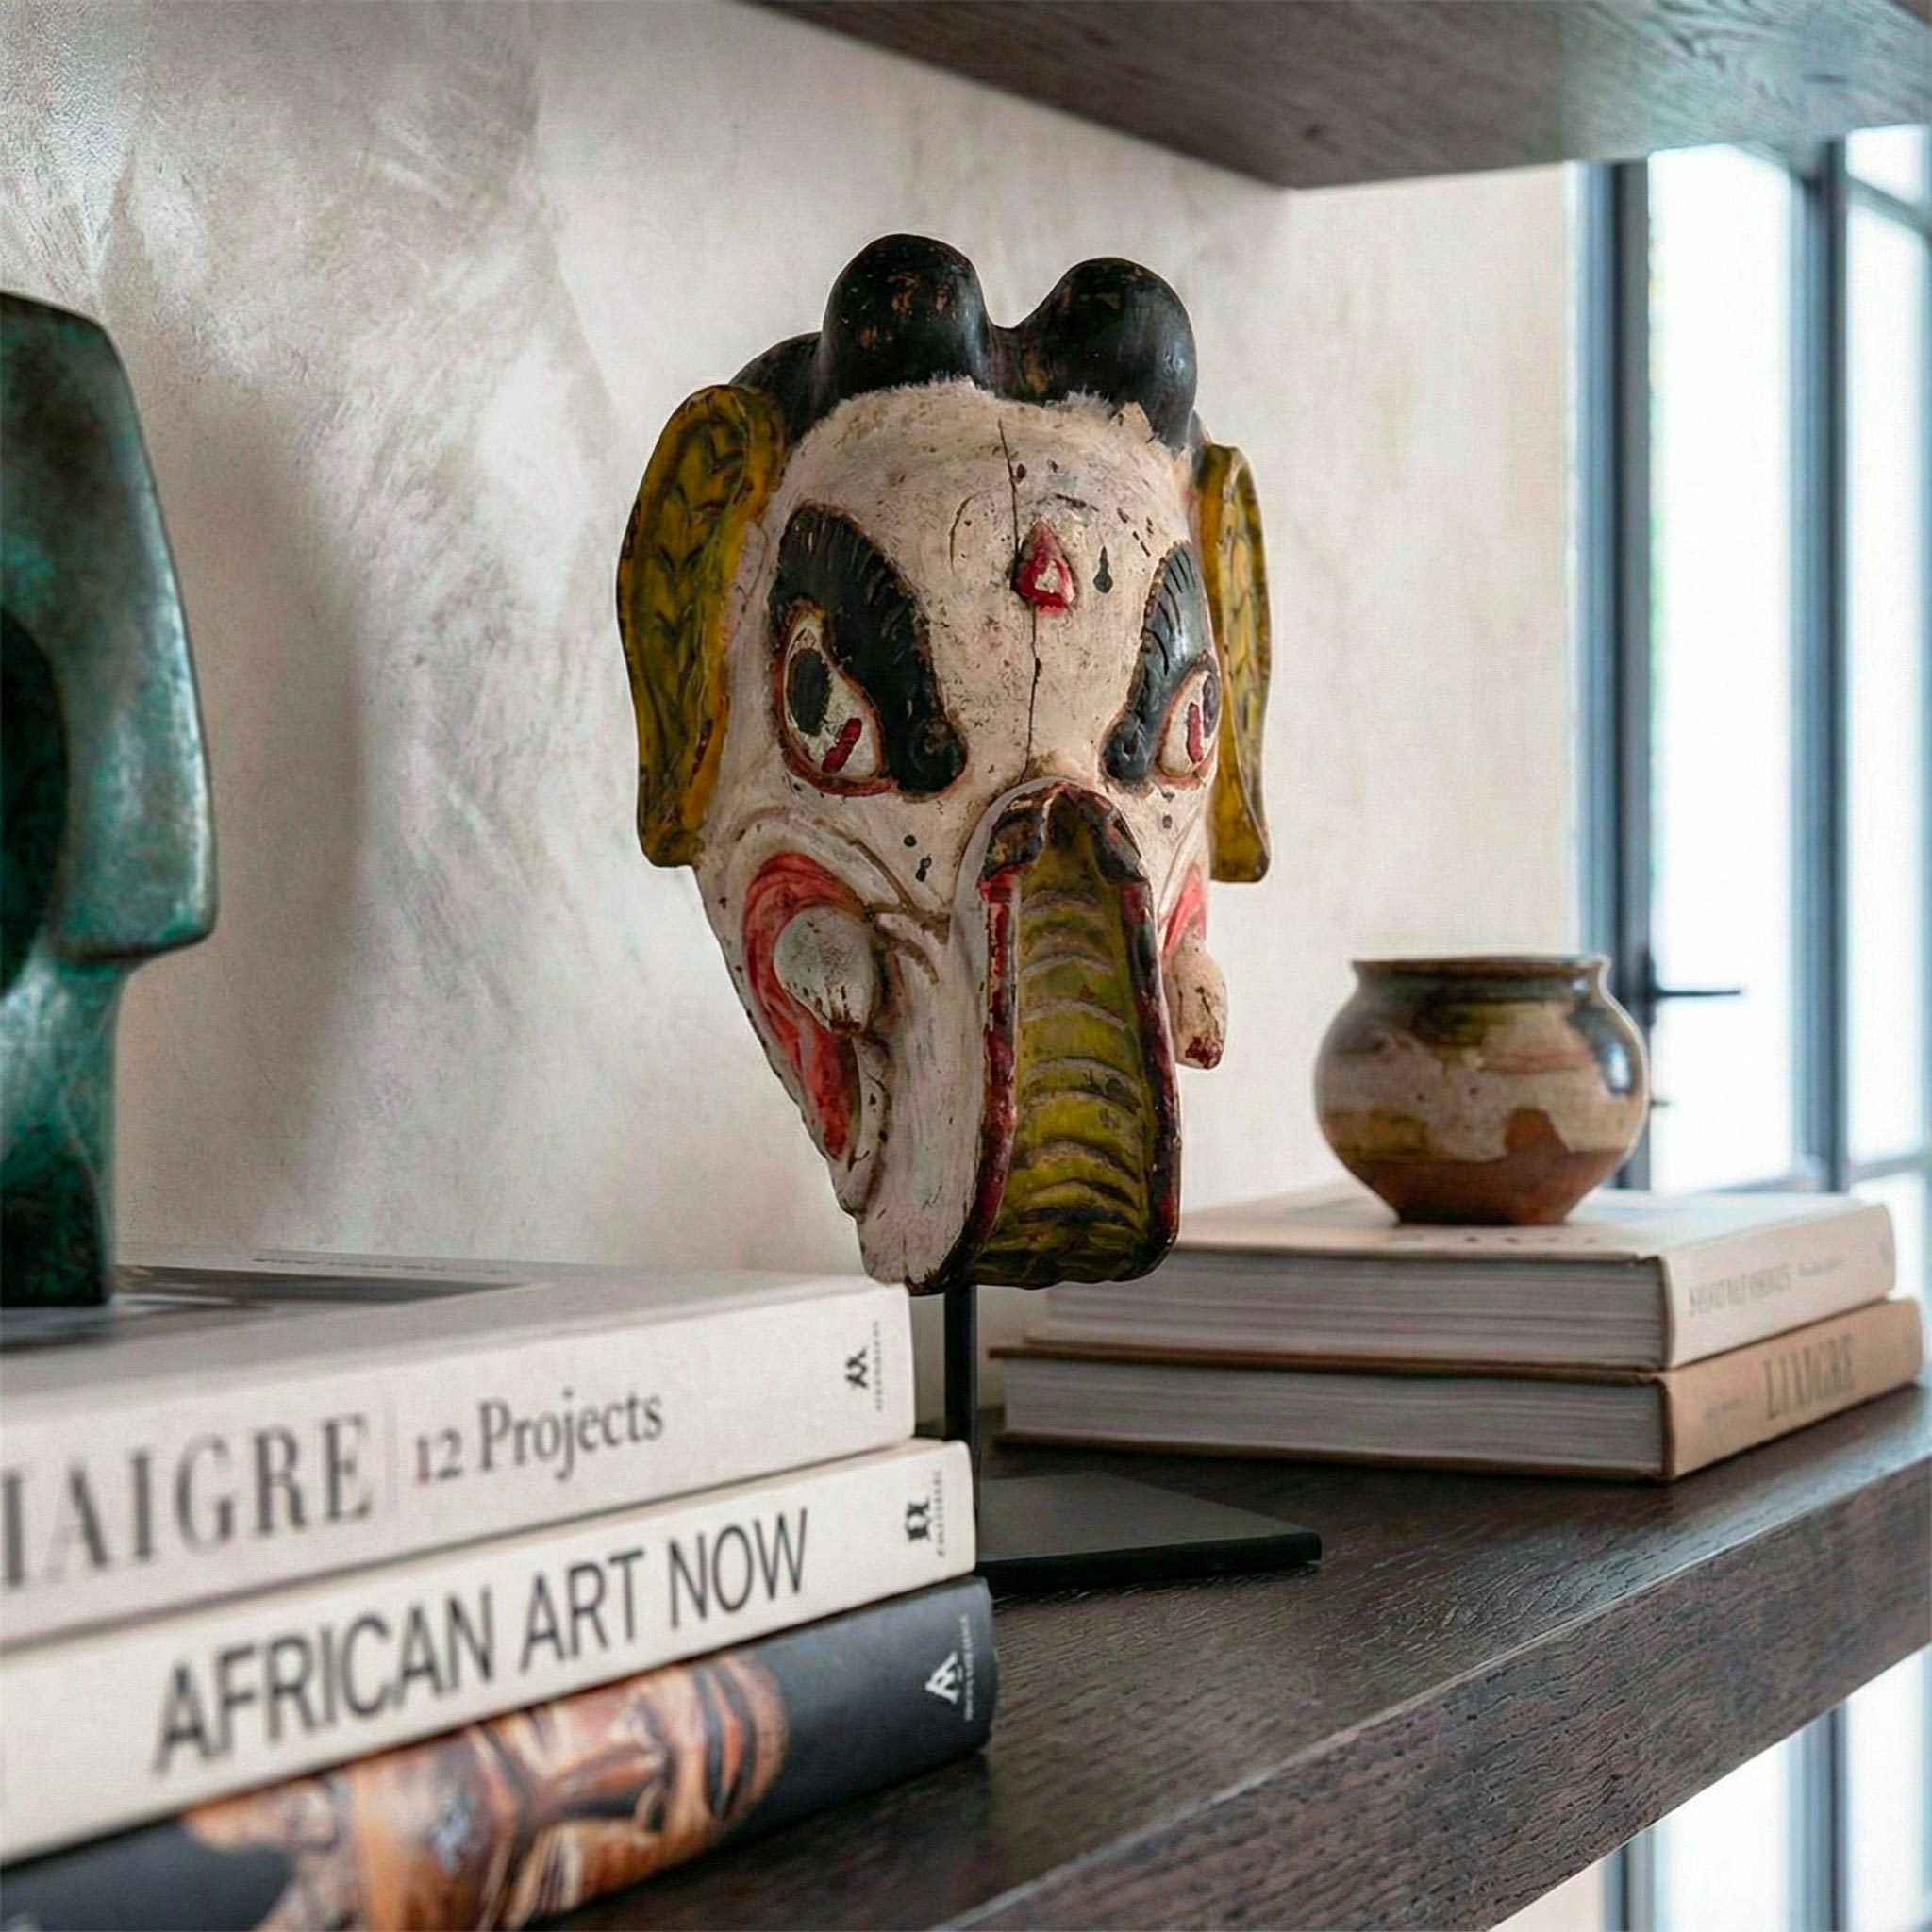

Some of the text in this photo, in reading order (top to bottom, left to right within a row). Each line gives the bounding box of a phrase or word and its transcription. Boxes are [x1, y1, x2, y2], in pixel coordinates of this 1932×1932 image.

[415, 1428, 463, 1482] 12
[477, 1385, 664, 1481] Projects
[153, 1585, 495, 1774] AFRICAN
[519, 1546, 645, 1674] ART
[668, 1507, 808, 1629] NOW
